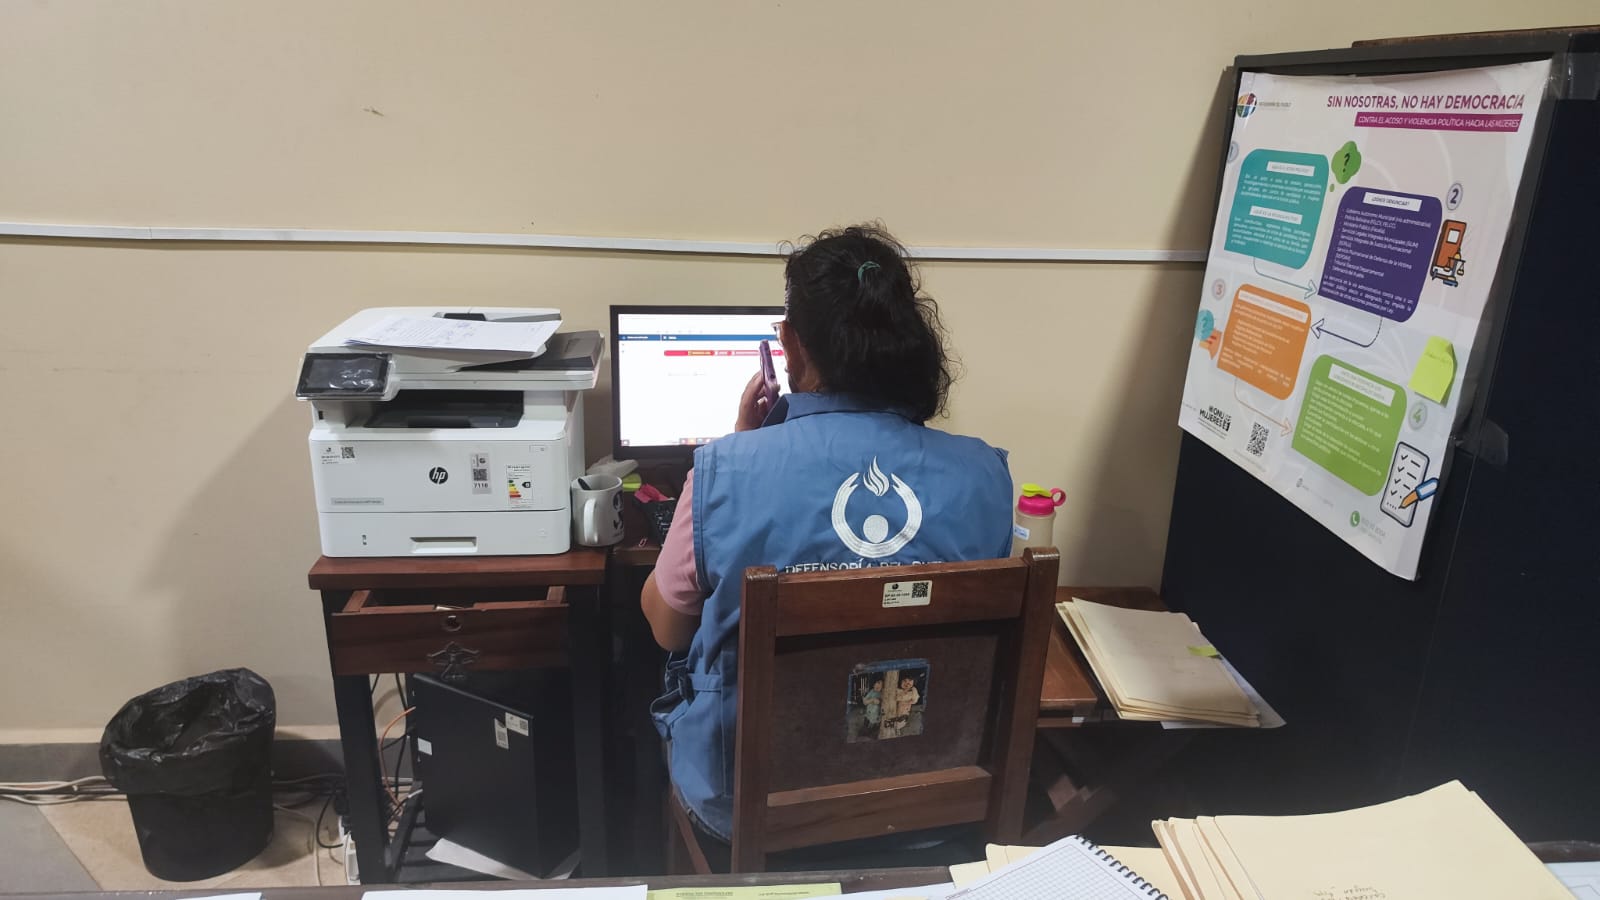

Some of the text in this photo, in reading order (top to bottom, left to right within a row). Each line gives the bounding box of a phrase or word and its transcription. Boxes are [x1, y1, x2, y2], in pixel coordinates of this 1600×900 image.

[1327, 94, 1525, 110] SIN NOSOTRAS, NO HAY DEMOCRACIA
[1358, 116, 1378, 124] CONTRA
[1385, 117, 1403, 125] ACOSO
[1408, 117, 1437, 126] VIOLENCIA
[1465, 119, 1484, 127] HACIA
[1450, 188, 1460, 204] 2
[431, 467, 447, 484] hp
